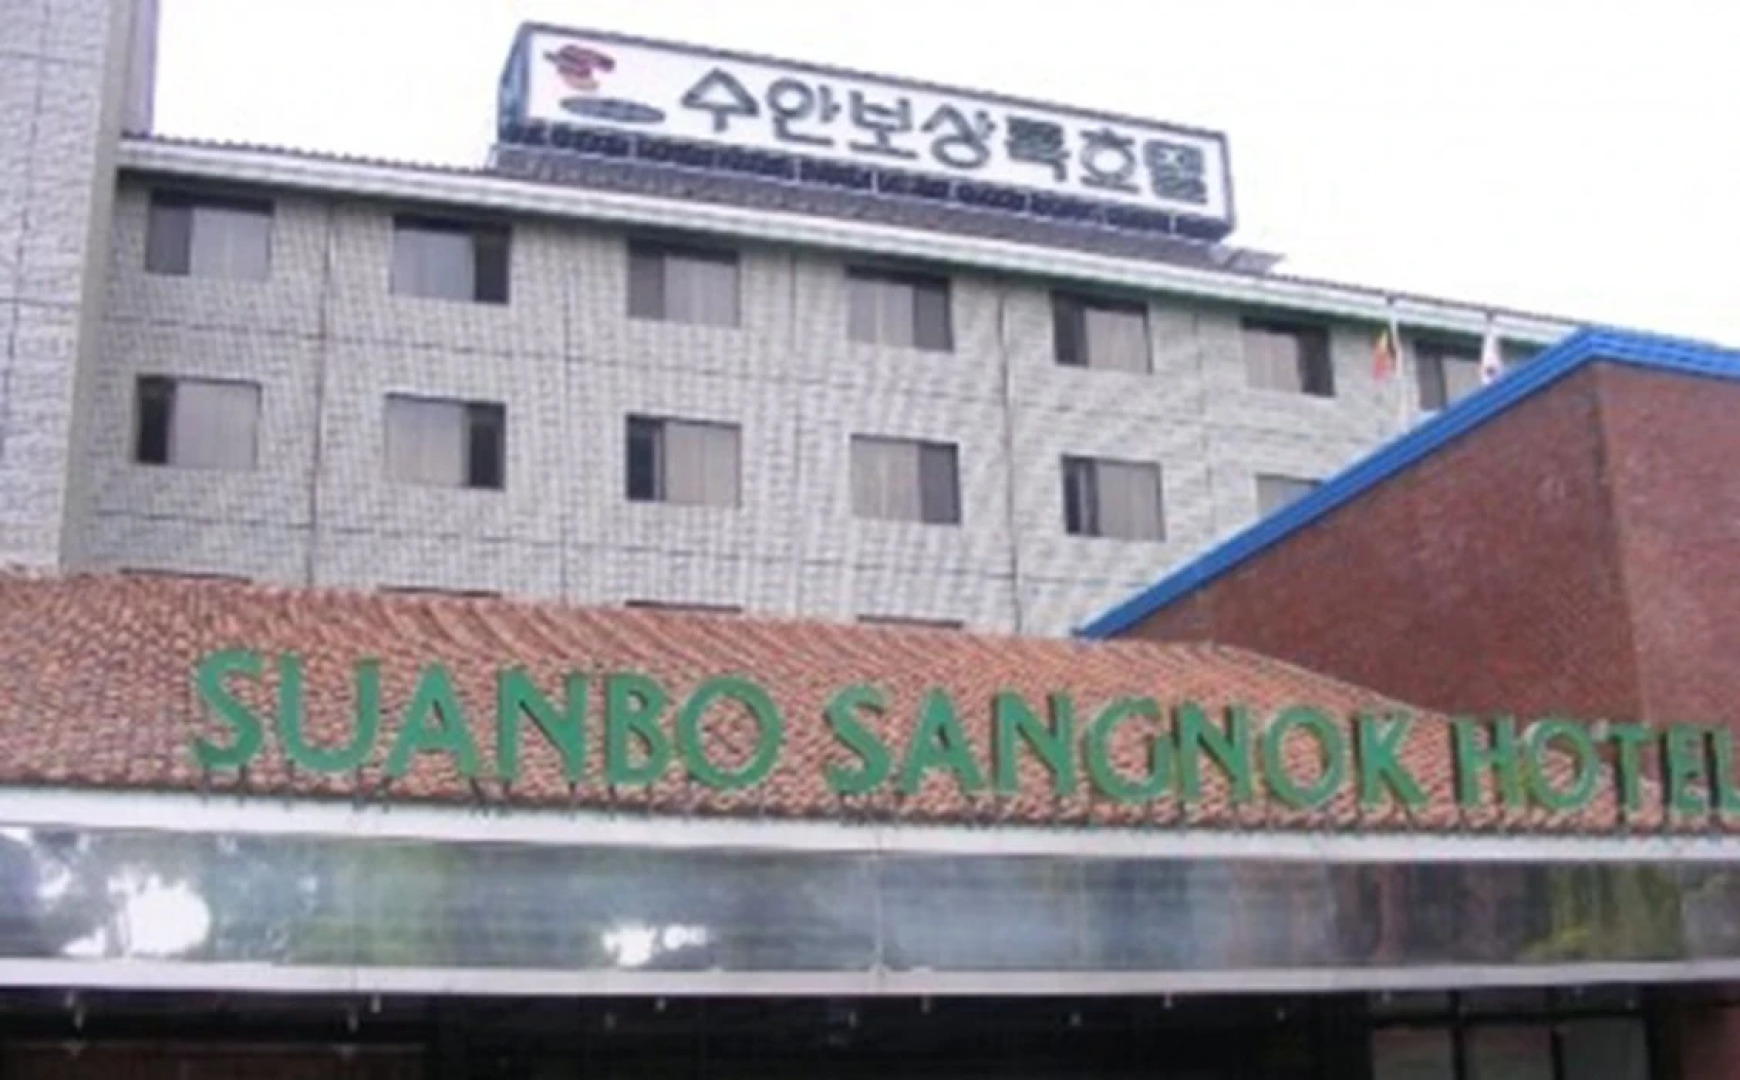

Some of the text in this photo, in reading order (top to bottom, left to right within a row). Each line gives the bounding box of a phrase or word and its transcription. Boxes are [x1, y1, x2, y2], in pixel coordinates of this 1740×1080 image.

[680, 68, 1208, 205] 수안보상록호텔
[192, 647, 1740, 814] SUANBO SANGNOK HOTEL
